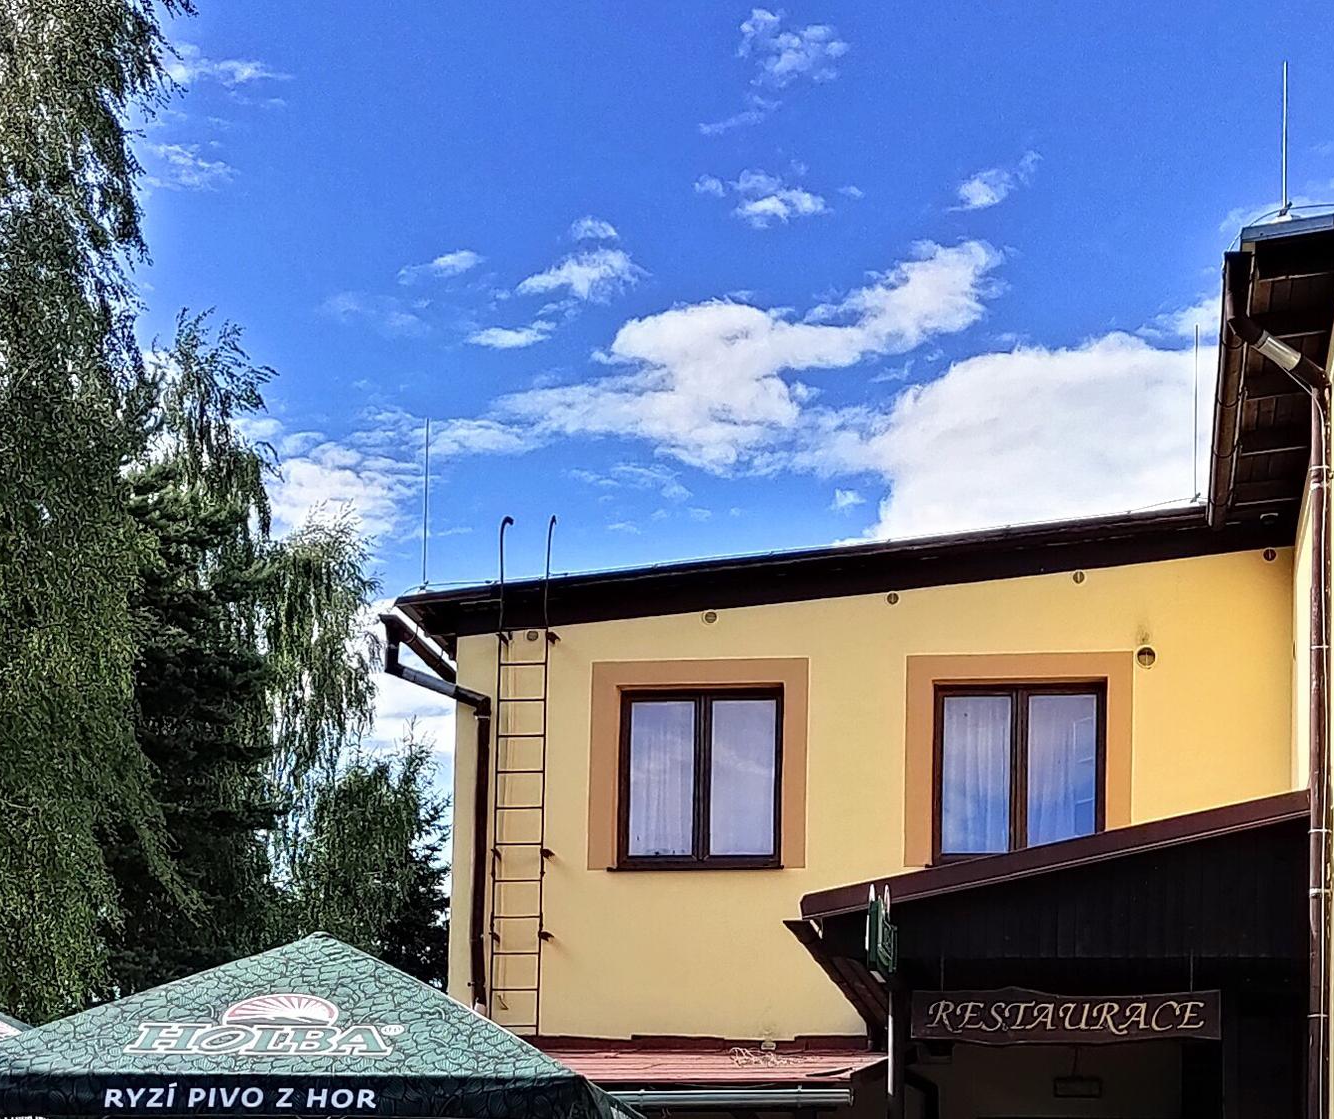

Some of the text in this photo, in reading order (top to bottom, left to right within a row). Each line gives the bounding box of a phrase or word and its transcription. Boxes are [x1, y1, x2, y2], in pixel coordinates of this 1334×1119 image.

[926, 1000, 1206, 1035] RESTAURACE
[124, 1022, 394, 1056] HOLBA
[104, 1083, 377, 1109] RYZÍ PIVO Z HOR
